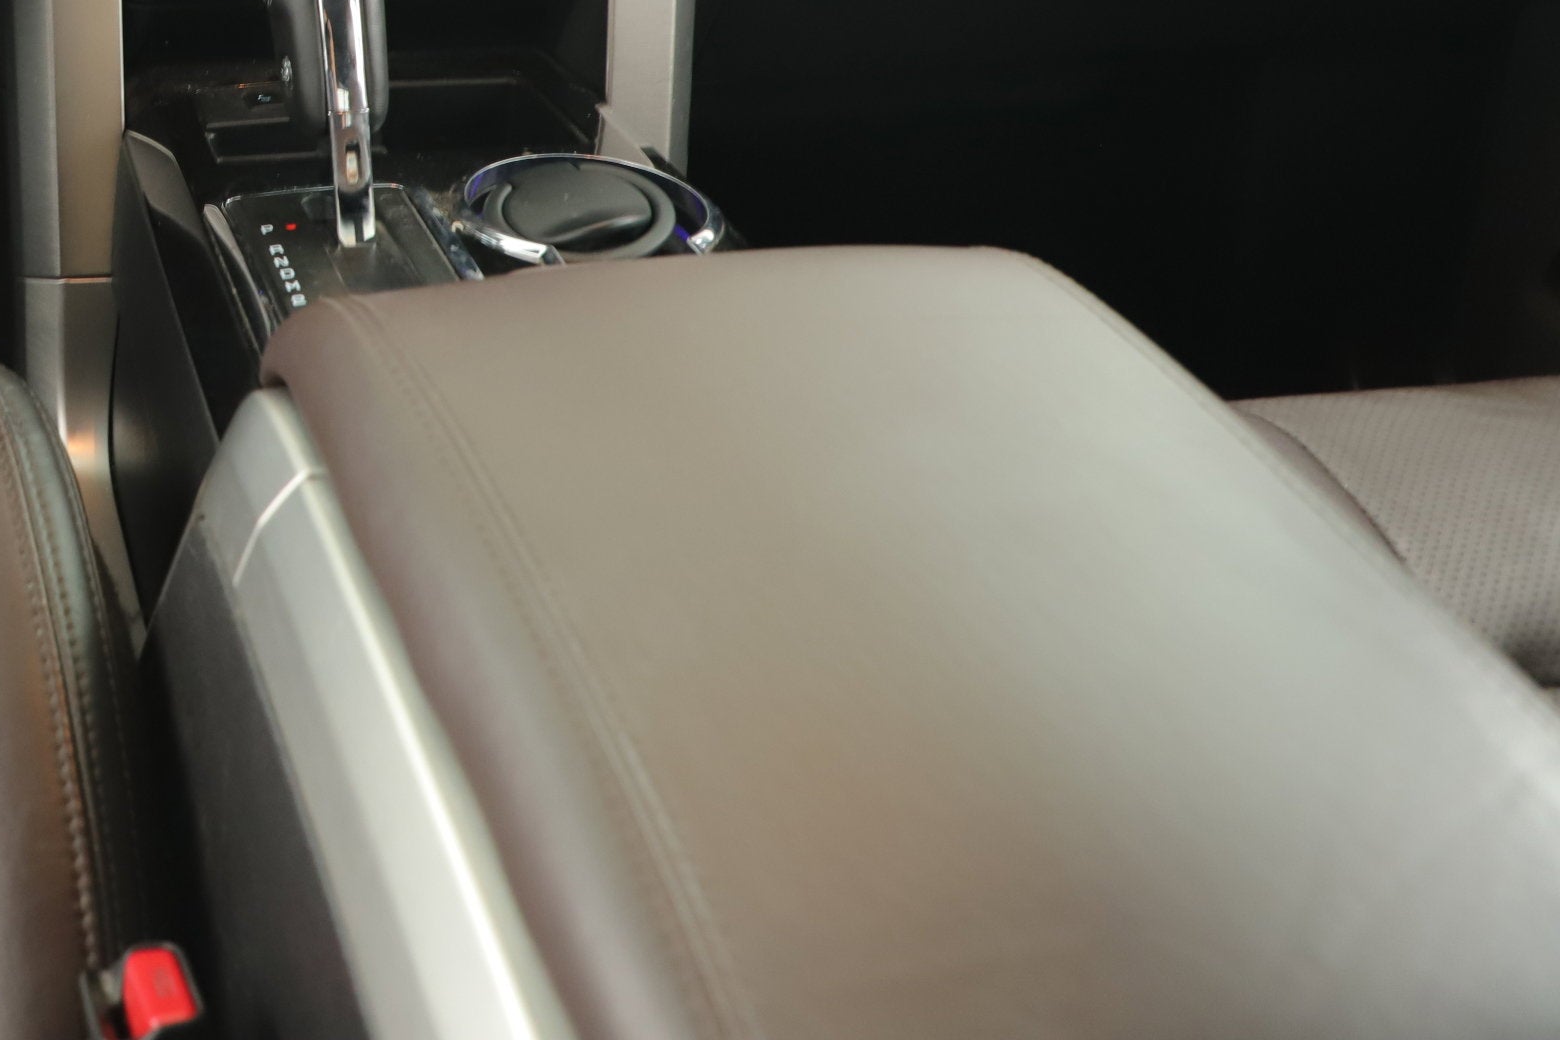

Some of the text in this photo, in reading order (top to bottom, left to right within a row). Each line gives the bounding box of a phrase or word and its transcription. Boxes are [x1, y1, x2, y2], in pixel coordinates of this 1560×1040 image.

[261, 224, 274, 236] P
[273, 255, 289, 268] N
[280, 268, 296, 280] D
[285, 280, 301, 293] M
